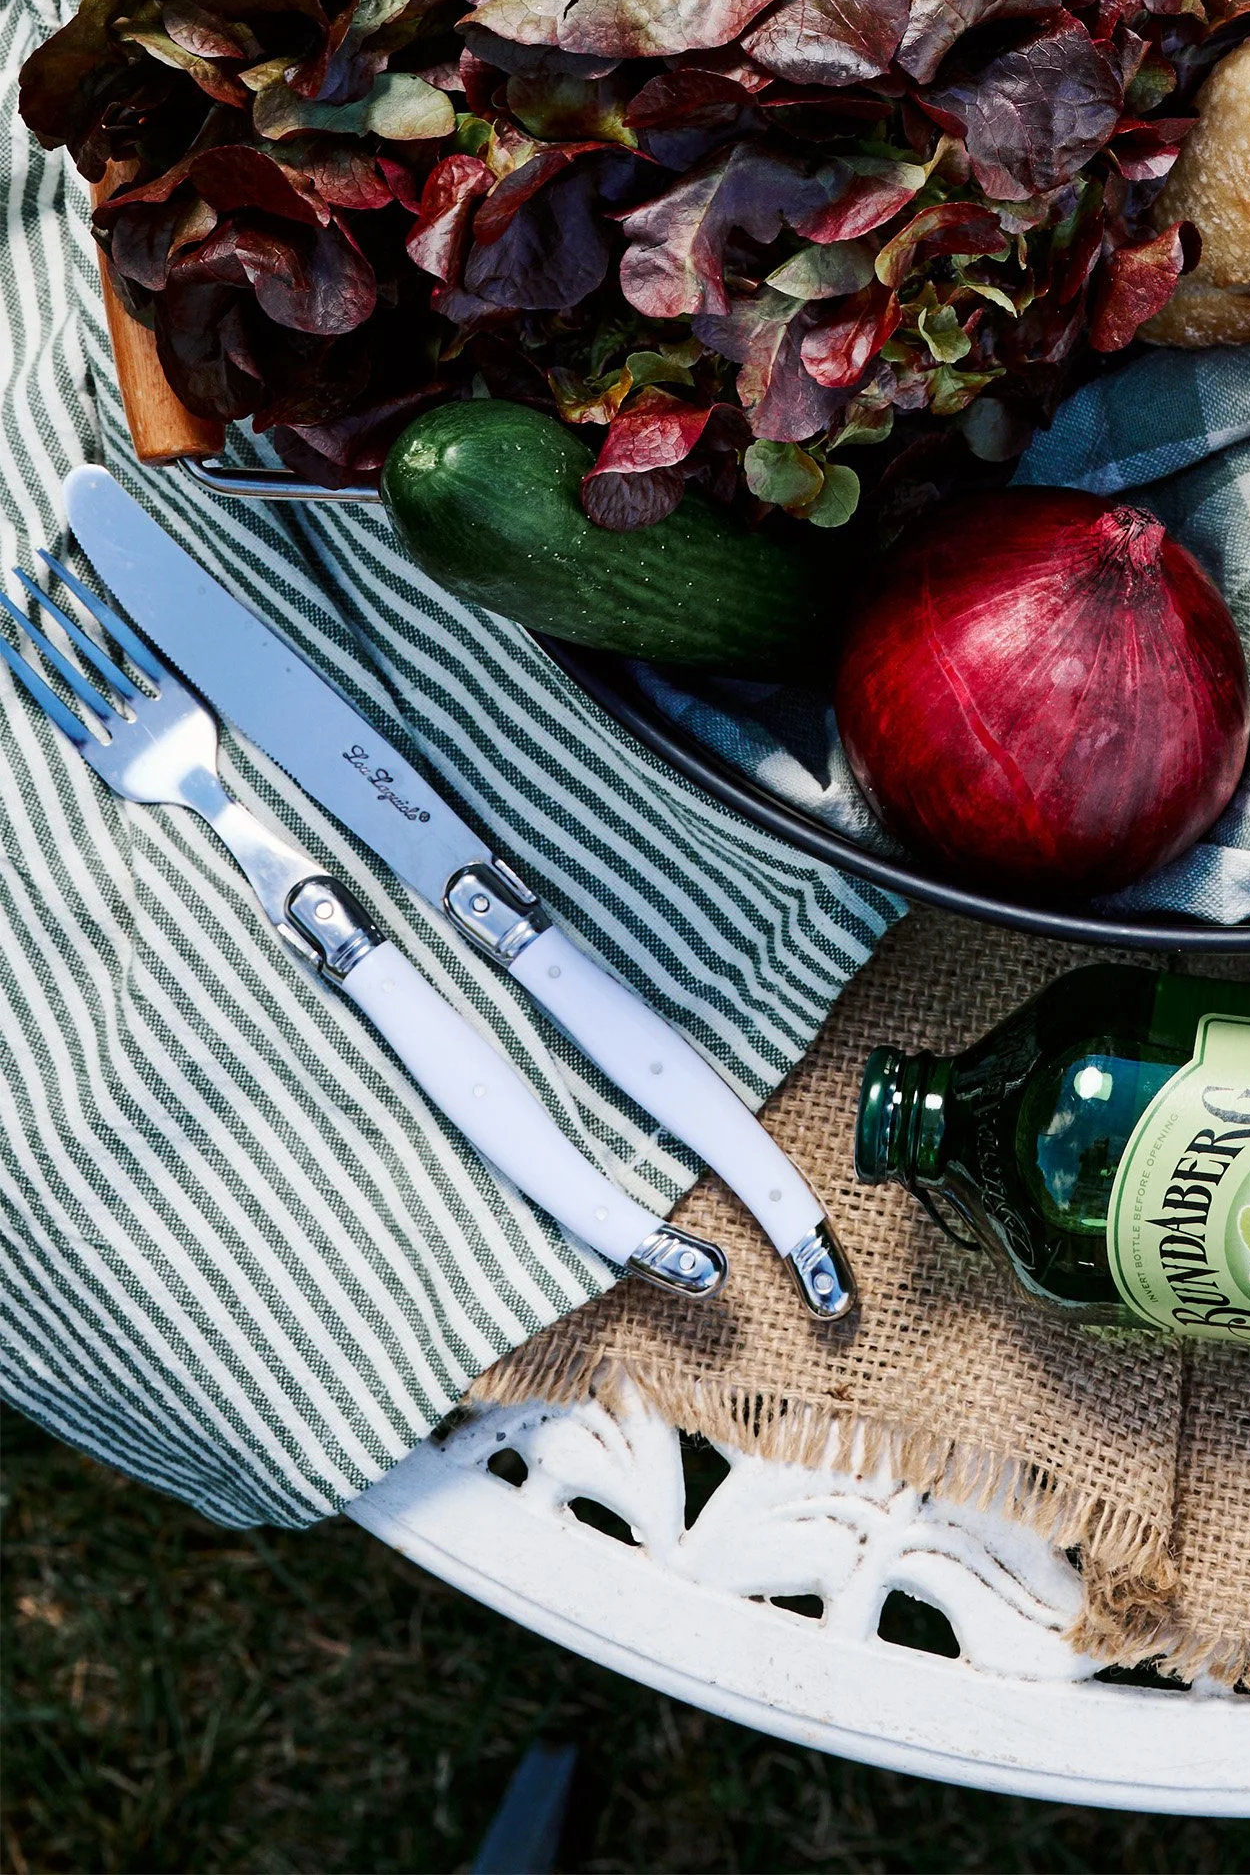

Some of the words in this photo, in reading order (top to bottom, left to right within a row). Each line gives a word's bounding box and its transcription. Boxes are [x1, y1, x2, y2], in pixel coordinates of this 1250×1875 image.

[1148, 1113, 1179, 1167] OPENING
[1133, 1170, 1150, 1220] BEFORE
[1133, 1226, 1143, 1268] BOTTLE
[1137, 1271, 1159, 1303] INVERT
